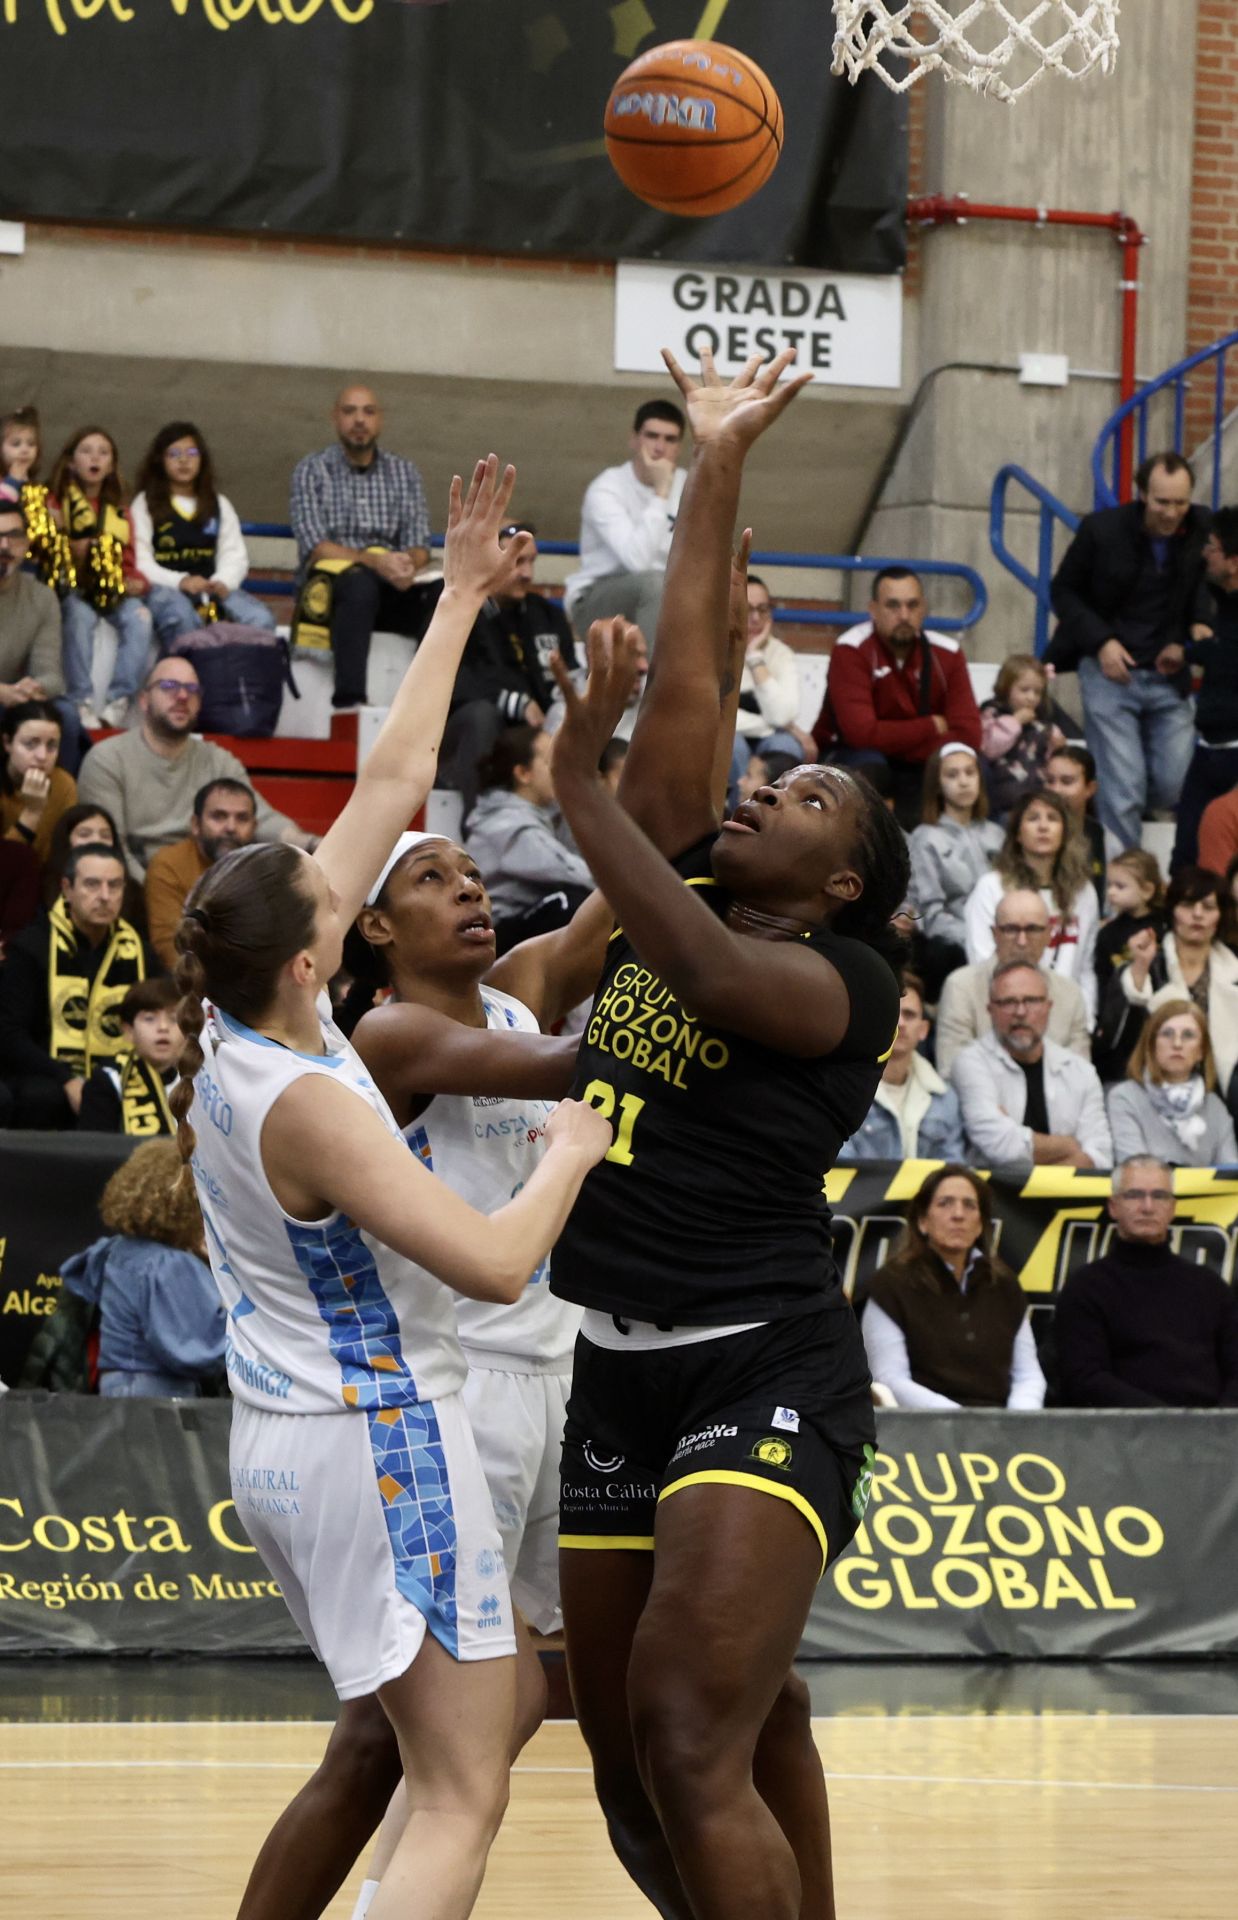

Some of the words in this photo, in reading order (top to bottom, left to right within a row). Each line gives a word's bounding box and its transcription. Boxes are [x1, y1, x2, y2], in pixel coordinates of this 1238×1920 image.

[673, 273, 847, 321] GRADA
[685, 323, 832, 368] OESTE
[596, 987, 729, 1070] HOZONO
[587, 1016, 688, 1090] GLOBAL
[563, 1482, 600, 1499] Costa
[605, 1482, 660, 1499] Cálid
[134, 1573, 180, 1600] de
[833, 1557, 1137, 1609] GLOBAL
